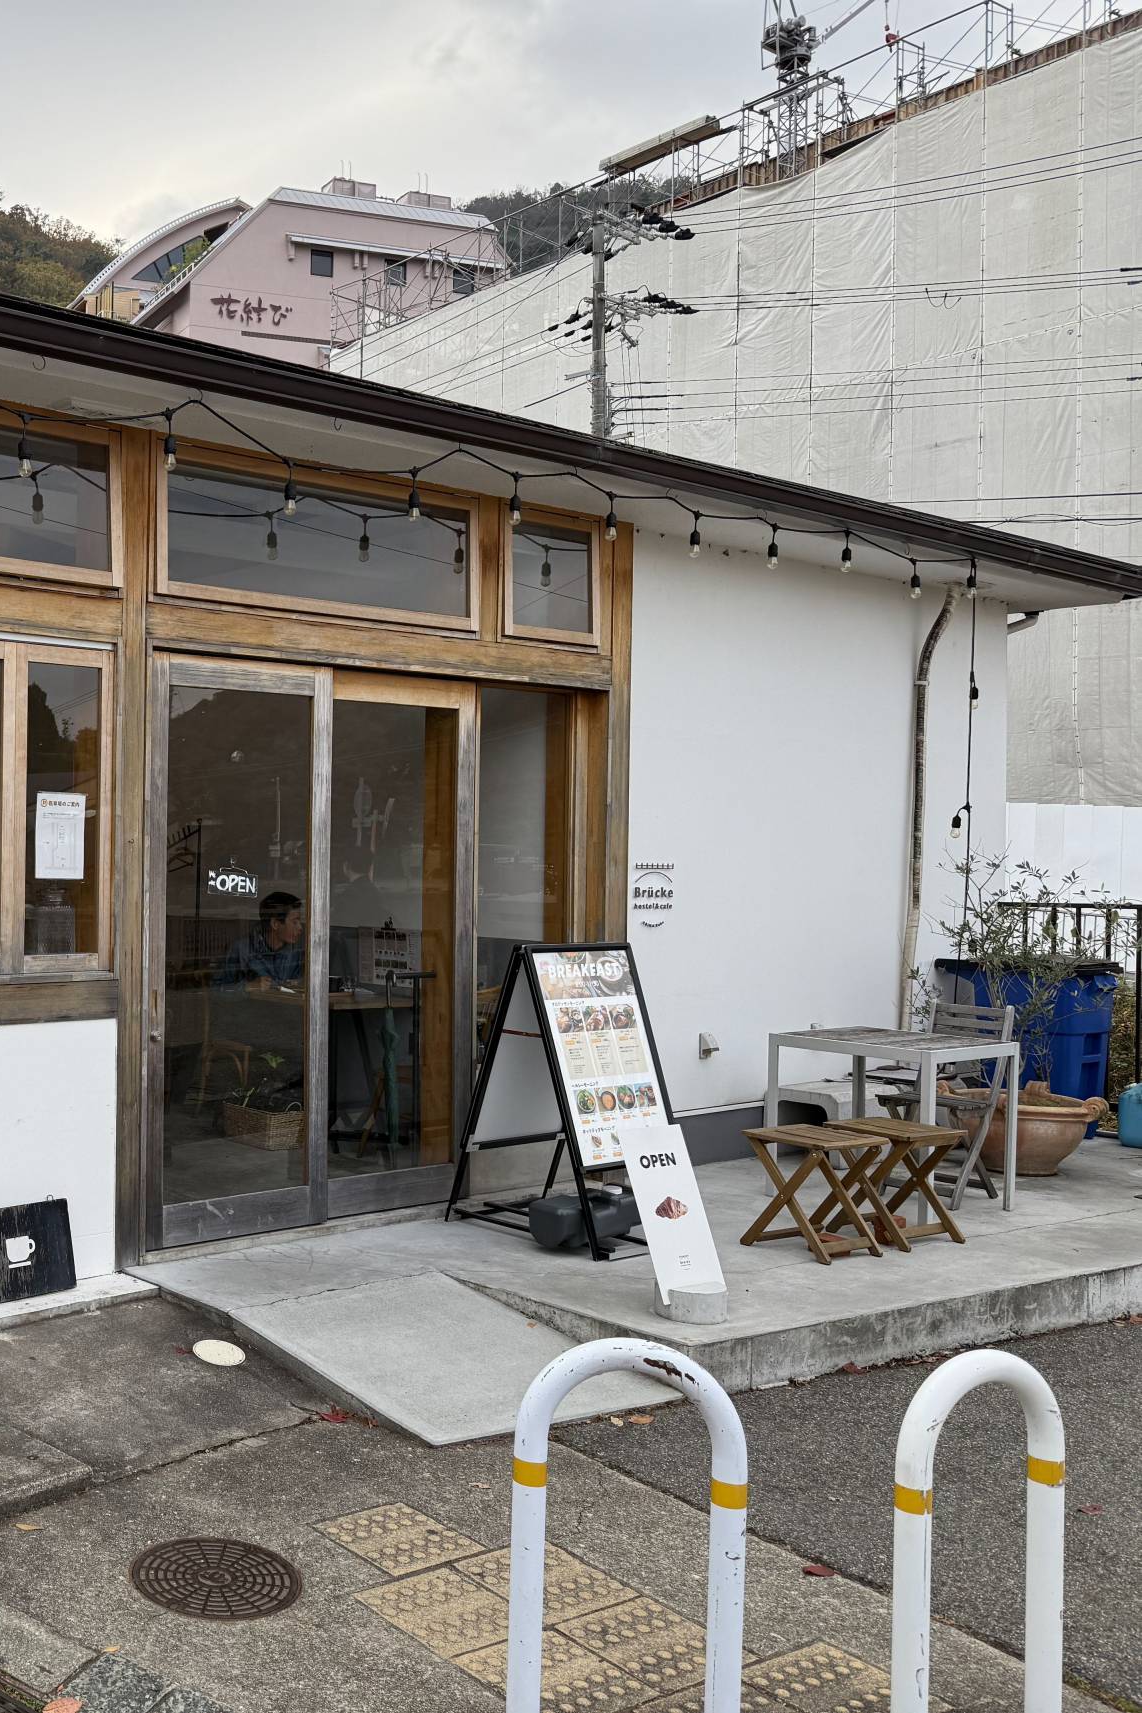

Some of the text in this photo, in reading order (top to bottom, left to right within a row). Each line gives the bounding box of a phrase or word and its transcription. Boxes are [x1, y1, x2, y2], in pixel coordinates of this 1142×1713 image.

[210, 292, 293, 326] 花結び
[216, 874, 256, 894] OPEN
[634, 886, 674, 898] Brücke
[639, 1152, 677, 1169] OPEN
